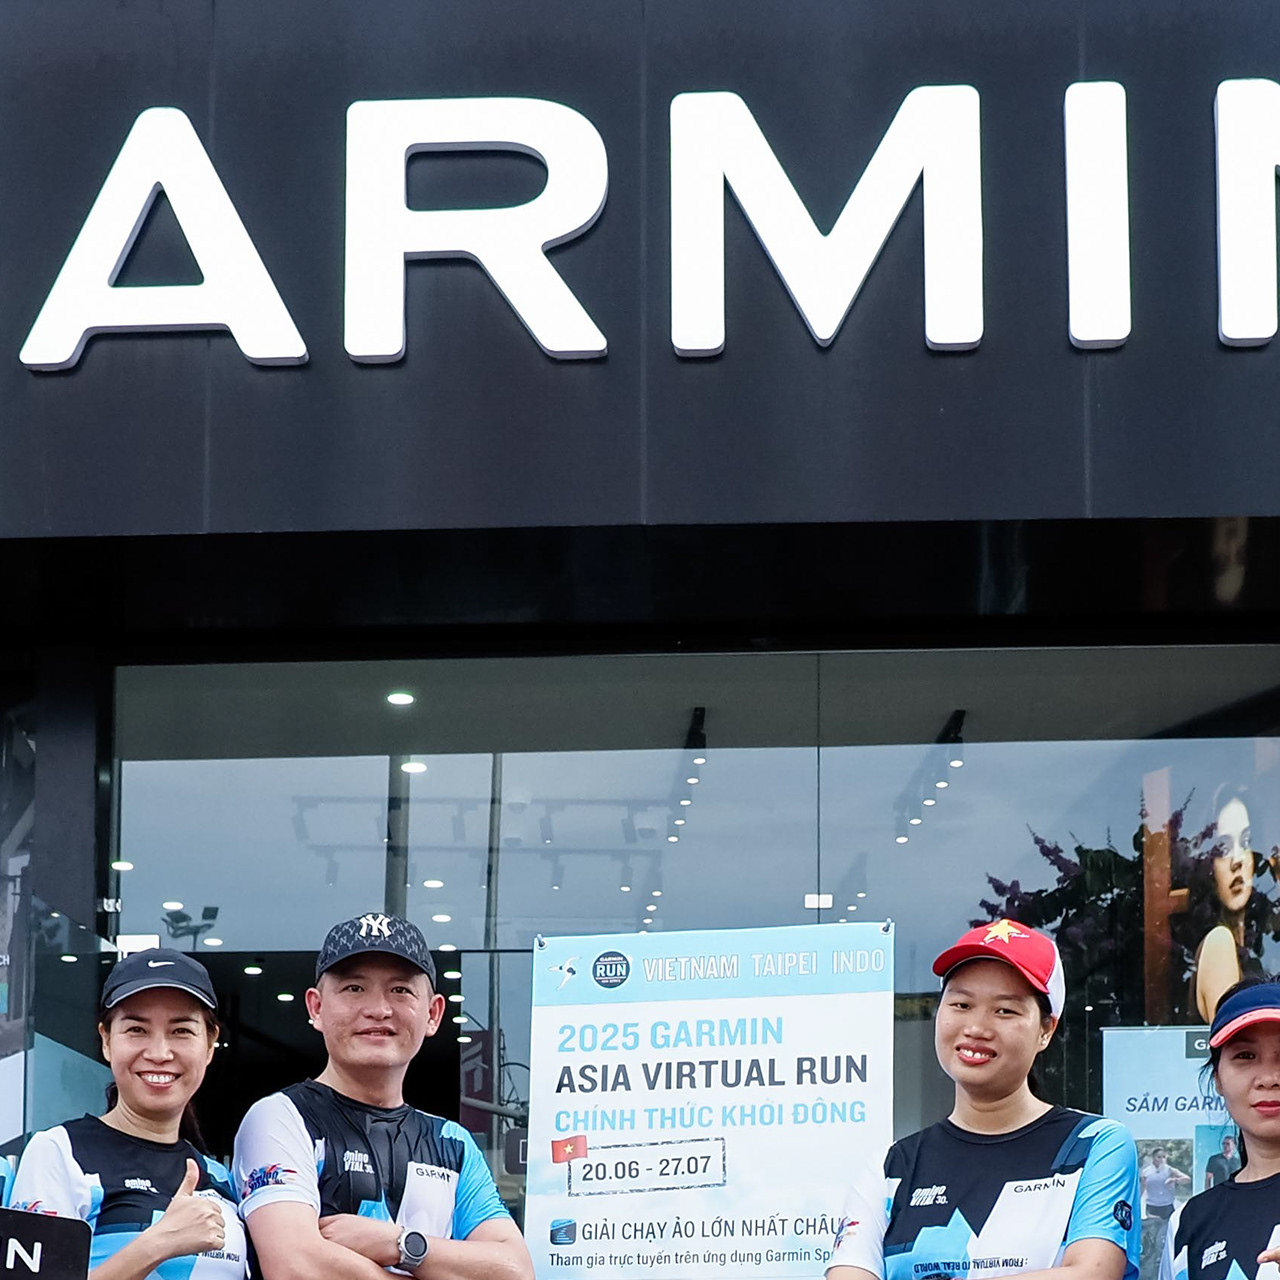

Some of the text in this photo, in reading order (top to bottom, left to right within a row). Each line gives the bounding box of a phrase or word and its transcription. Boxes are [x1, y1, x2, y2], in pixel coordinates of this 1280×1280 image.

[359, 914, 391, 937] NY
[596, 964, 627, 977] RUN
[643, 948, 885, 982] VIETNAM TAIPEI INDO
[557, 1017, 783, 1053] 2025 GARMIN
[555, 1054, 868, 1094] ASIA VIRTUAL RUN
[1125, 1091, 1169, 1112] SẮM
[555, 1104, 636, 1132] CHÍNH
[643, 1100, 713, 1129] THỨC
[792, 1097, 866, 1128] ĐỘNG
[582, 1156, 712, 1181] 20.06 27.07
[1014, 1178, 1066, 1193] GARMIN
[581, 1215, 615, 1241] GIẢI
[621, 1218, 665, 1241] CHẠY
[672, 1213, 696, 1239] ẢO
[701, 1215, 735, 1238] LỚN
[741, 1213, 789, 1237] NHẤT
[548, 1253, 583, 1268] Tham
[586, 1253, 607, 1269] gia
[609, 1252, 633, 1267] trực
[636, 1249, 673, 1269] tuyến
[674, 1249, 701, 1265] trên
[703, 1249, 728, 1268] ứng
[730, 1248, 762, 1267] dụng
[765, 1247, 811, 1263] Garmin
